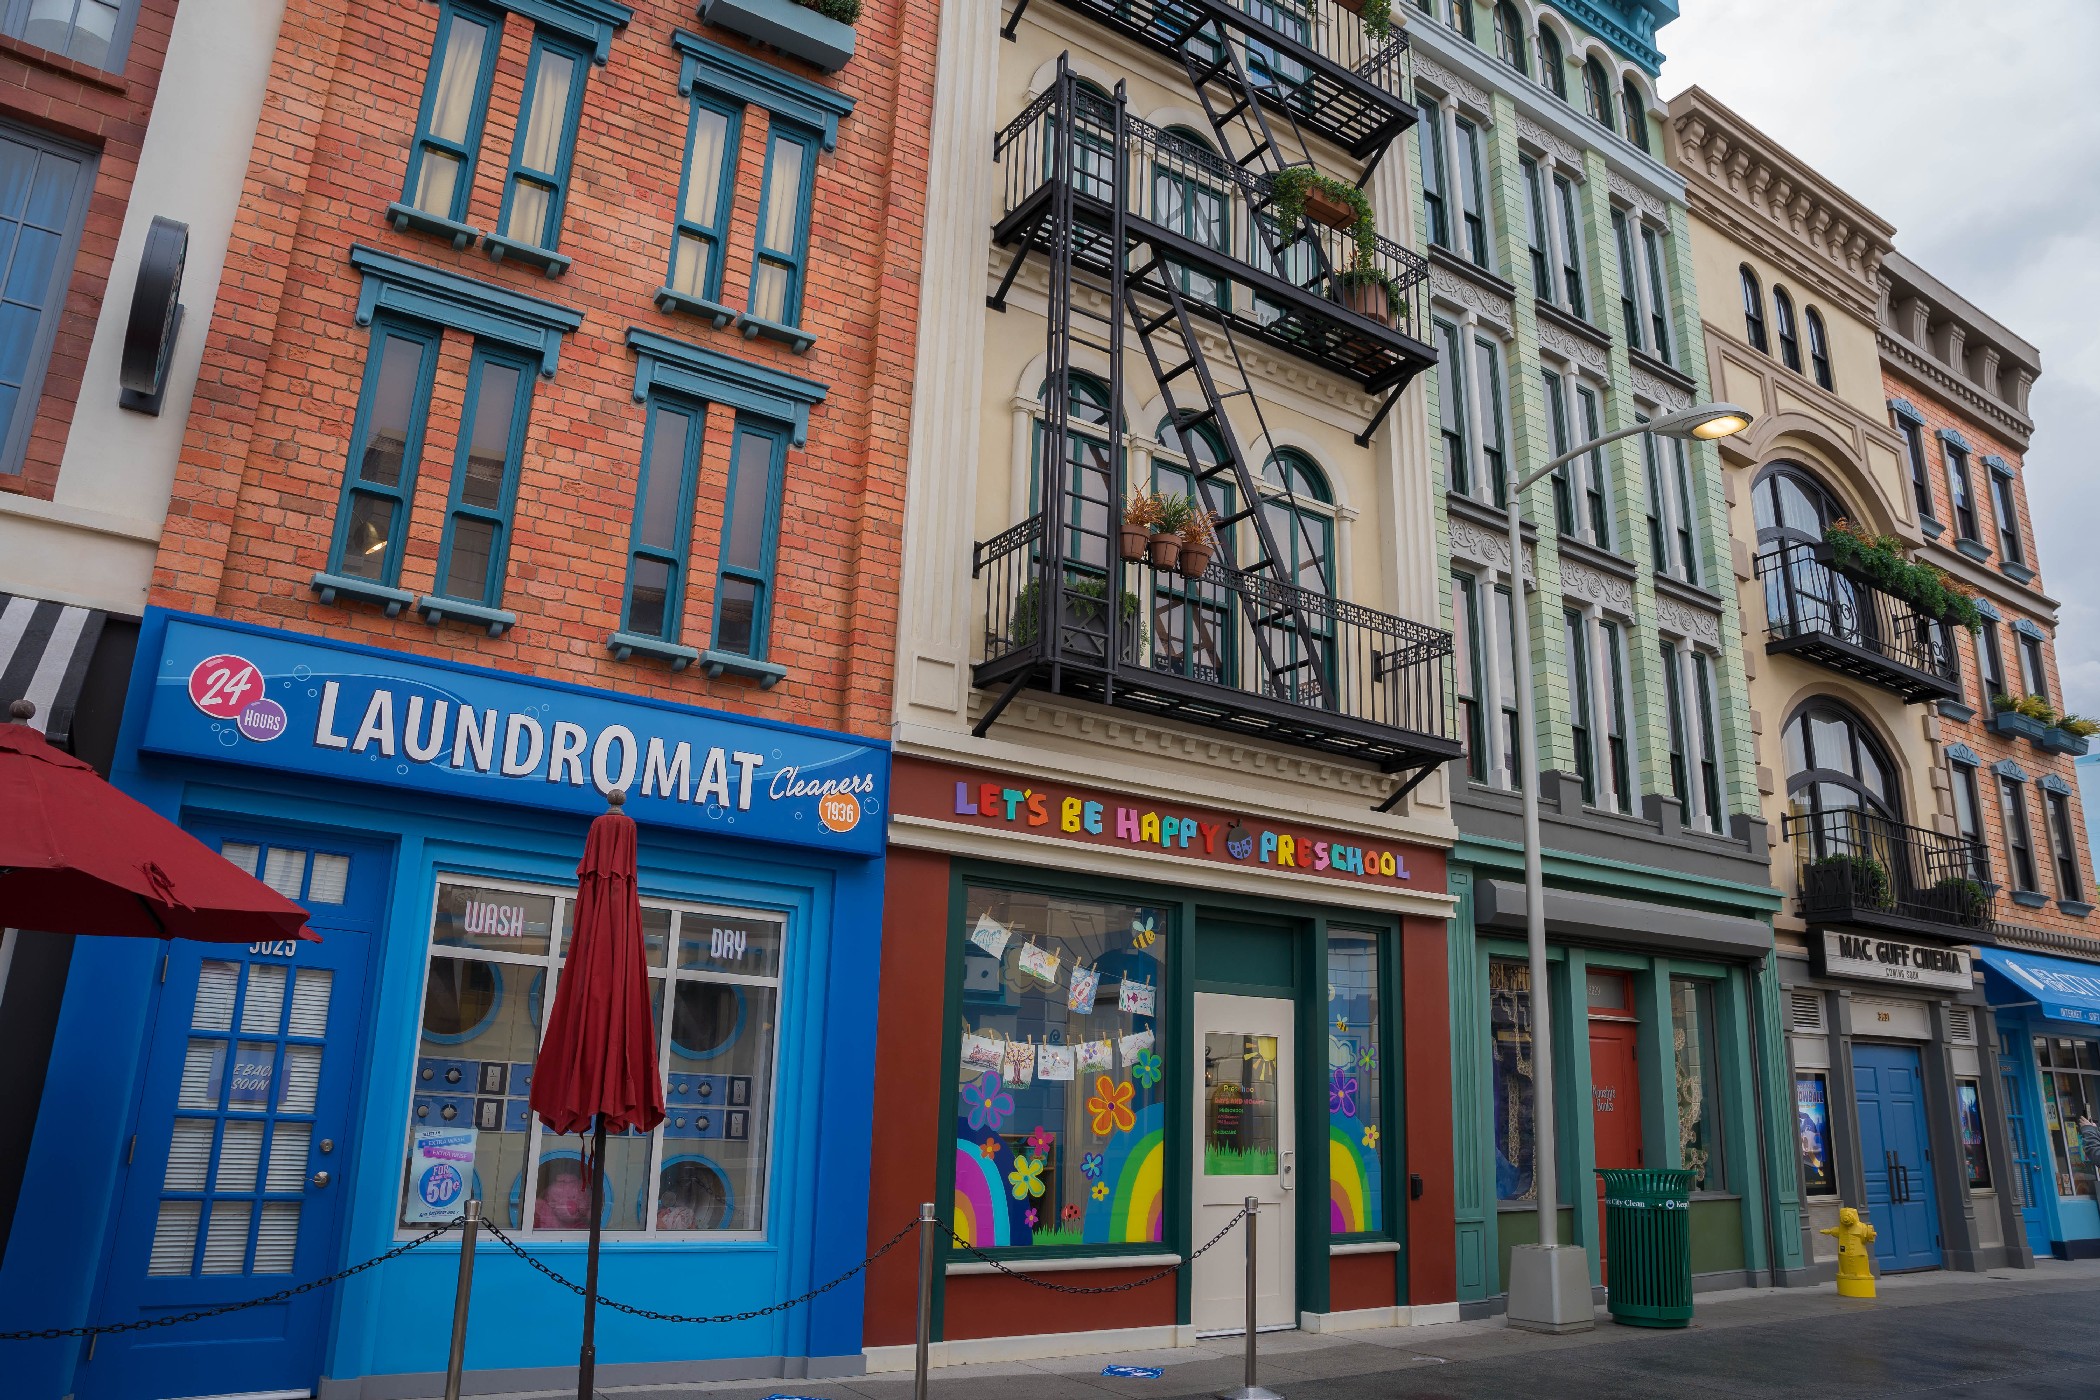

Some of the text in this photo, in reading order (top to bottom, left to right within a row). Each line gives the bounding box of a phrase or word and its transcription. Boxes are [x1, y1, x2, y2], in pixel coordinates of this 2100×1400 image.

[200, 665, 253, 706] 24
[243, 707, 282, 732] HOURS
[313, 680, 765, 812] LAUNDROMAT
[769, 765, 875, 801] Cleaners
[824, 800, 854, 824] 1936
[954, 780, 1411, 880] LET'S BE HAPPY PRESCHOOL
[464, 900, 525, 938] WASH
[711, 928, 747, 961] DRY
[1838, 935, 1963, 974] MAC GUFF CINEMA
[230, 1077, 270, 1091] SOON
[1797, 1090, 1825, 1104] OWBALL
[433, 1164, 450, 1175] FOR
[1624, 1199, 1646, 1208] Clean
